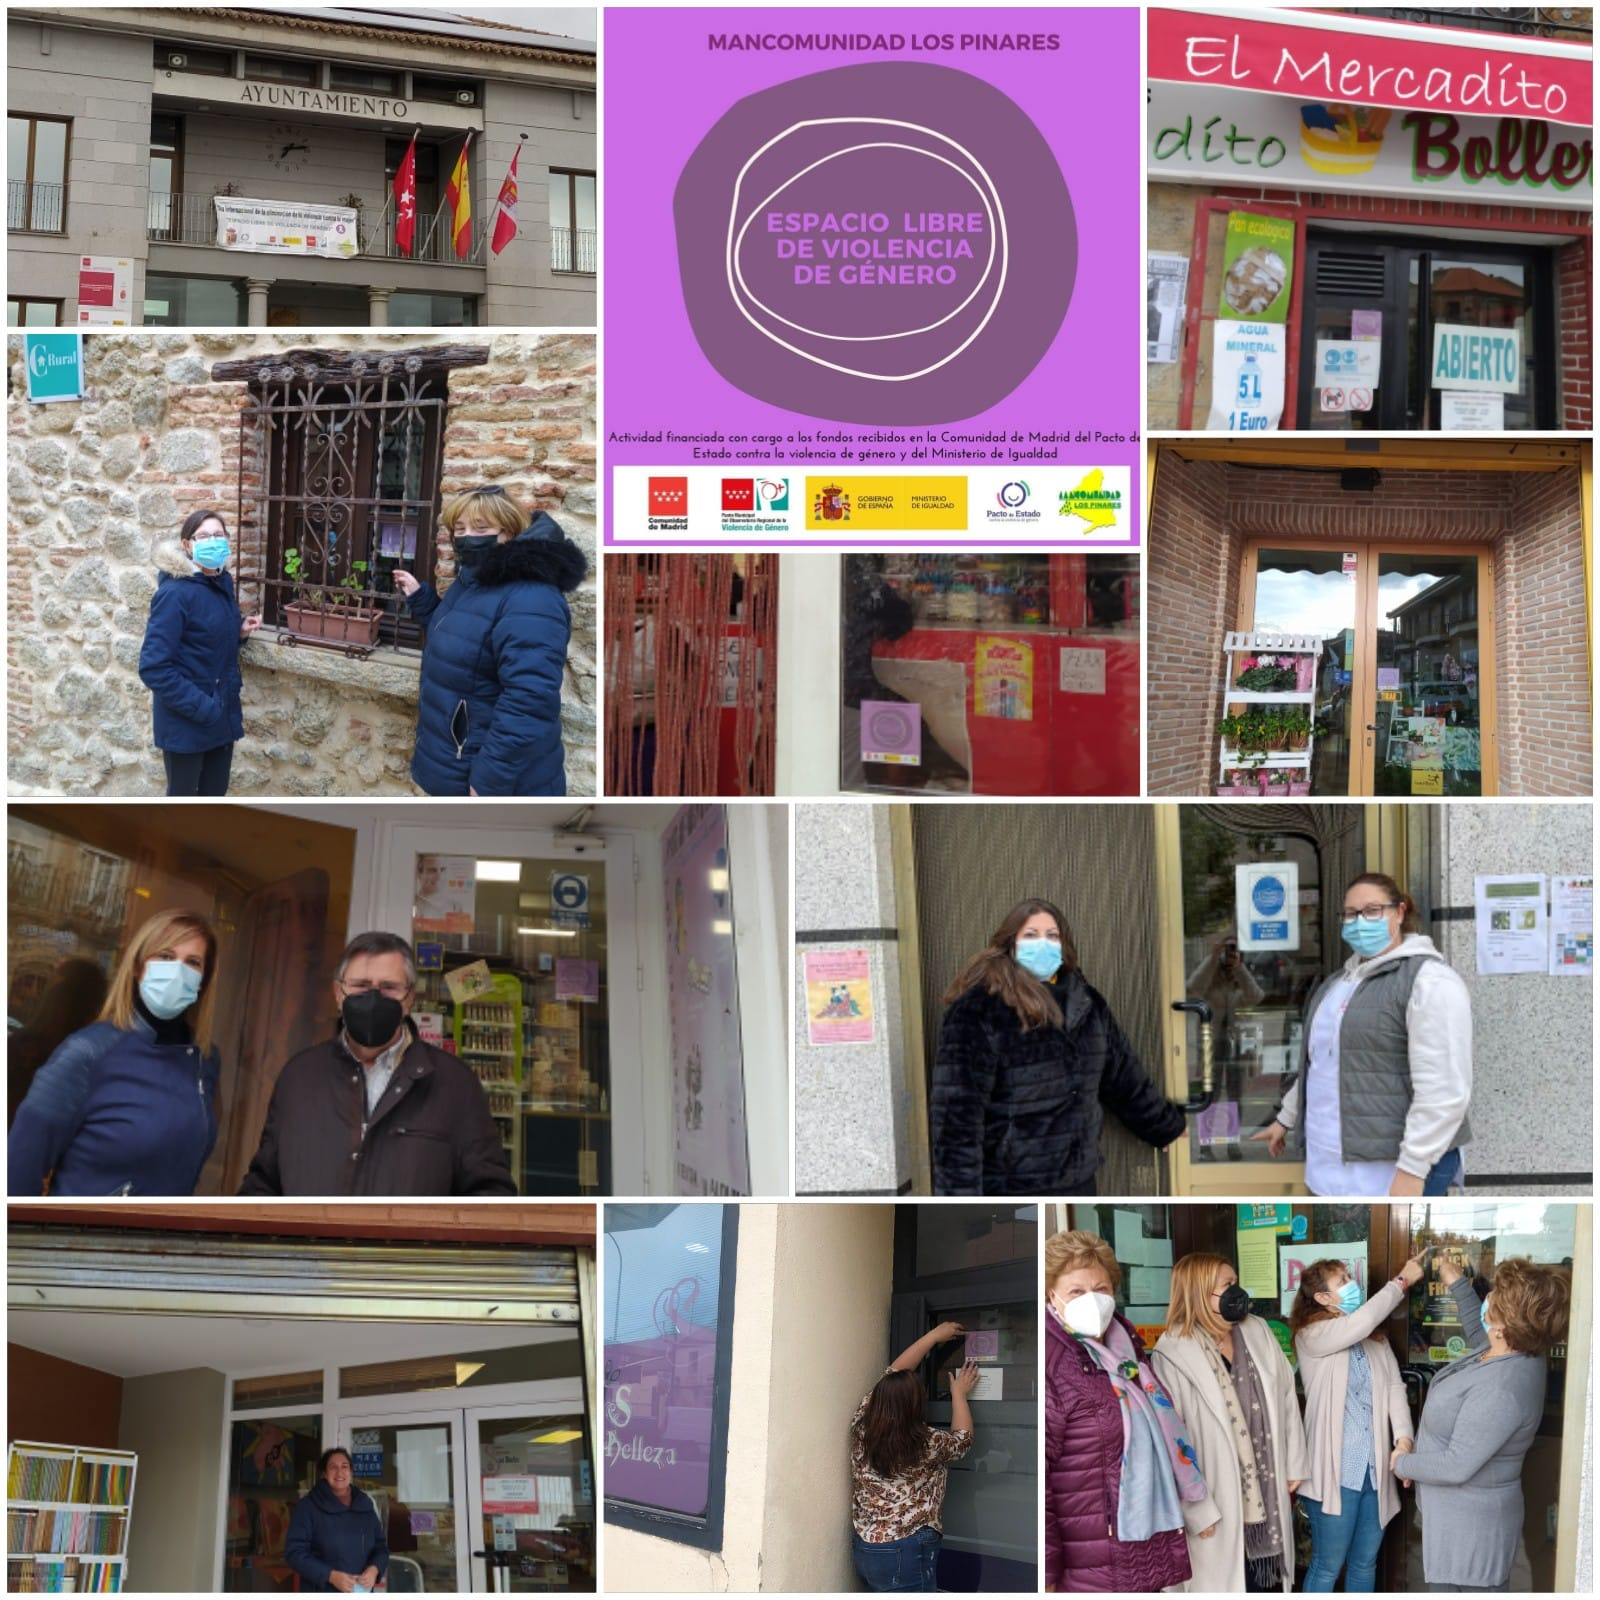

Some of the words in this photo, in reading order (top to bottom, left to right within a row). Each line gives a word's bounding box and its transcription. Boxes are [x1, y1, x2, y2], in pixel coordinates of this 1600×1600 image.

[708, 34, 905, 50] MANCOMUNIDAD
[912, 34, 954, 50] LOS
[961, 34, 1060, 50] PINARES
[1186, 34, 1251, 78] El
[240, 85, 408, 118] AYUNTAMIENTO
[767, 213, 889, 233] ESPACIO
[904, 213, 983, 233] LIBRE
[778, 239, 814, 258] DE
[822, 239, 973, 258] VIOLENCIA
[795, 265, 830, 284] DE
[839, 260, 956, 284] GÉNERO
[1237, 324, 1269, 336] AGUA
[1226, 341, 1277, 353] MINERAL
[48, 350, 77, 366] Rural
[1436, 334, 1516, 383] ABIERTO
[1239, 375, 1249, 399] 5
[1253, 375, 1262, 399] L
[1239, 411, 1268, 431] Euro
[609, 431, 662, 443] Actividad
[666, 431, 724, 443] financiada
[752, 436, 782, 446] cargo
[798, 431, 812, 443] los
[816, 431, 853, 443] fondos
[858, 431, 905, 443] recibidos
[927, 431, 936, 443] la
[941, 431, 1006, 443] Comunidad
[1011, 431, 1024, 443] de
[1029, 431, 1070, 443] Madrid
[1075, 431, 1090, 443] del
[1095, 431, 1125, 443] Pacto
[694, 447, 732, 458] Estado
[736, 449, 770, 458] contra
[775, 447, 784, 458] la
[789, 447, 836, 458] violencia
[841, 447, 853, 458] de
[859, 447, 895, 461] género
[900, 451, 906, 461] y
[911, 447, 927, 458] del
[932, 447, 986, 458] Ministerio
[991, 447, 1003, 458] de
[1009, 447, 1057, 461] Igualdad
[648, 523, 658, 531] de
[660, 523, 688, 531] Madrid
